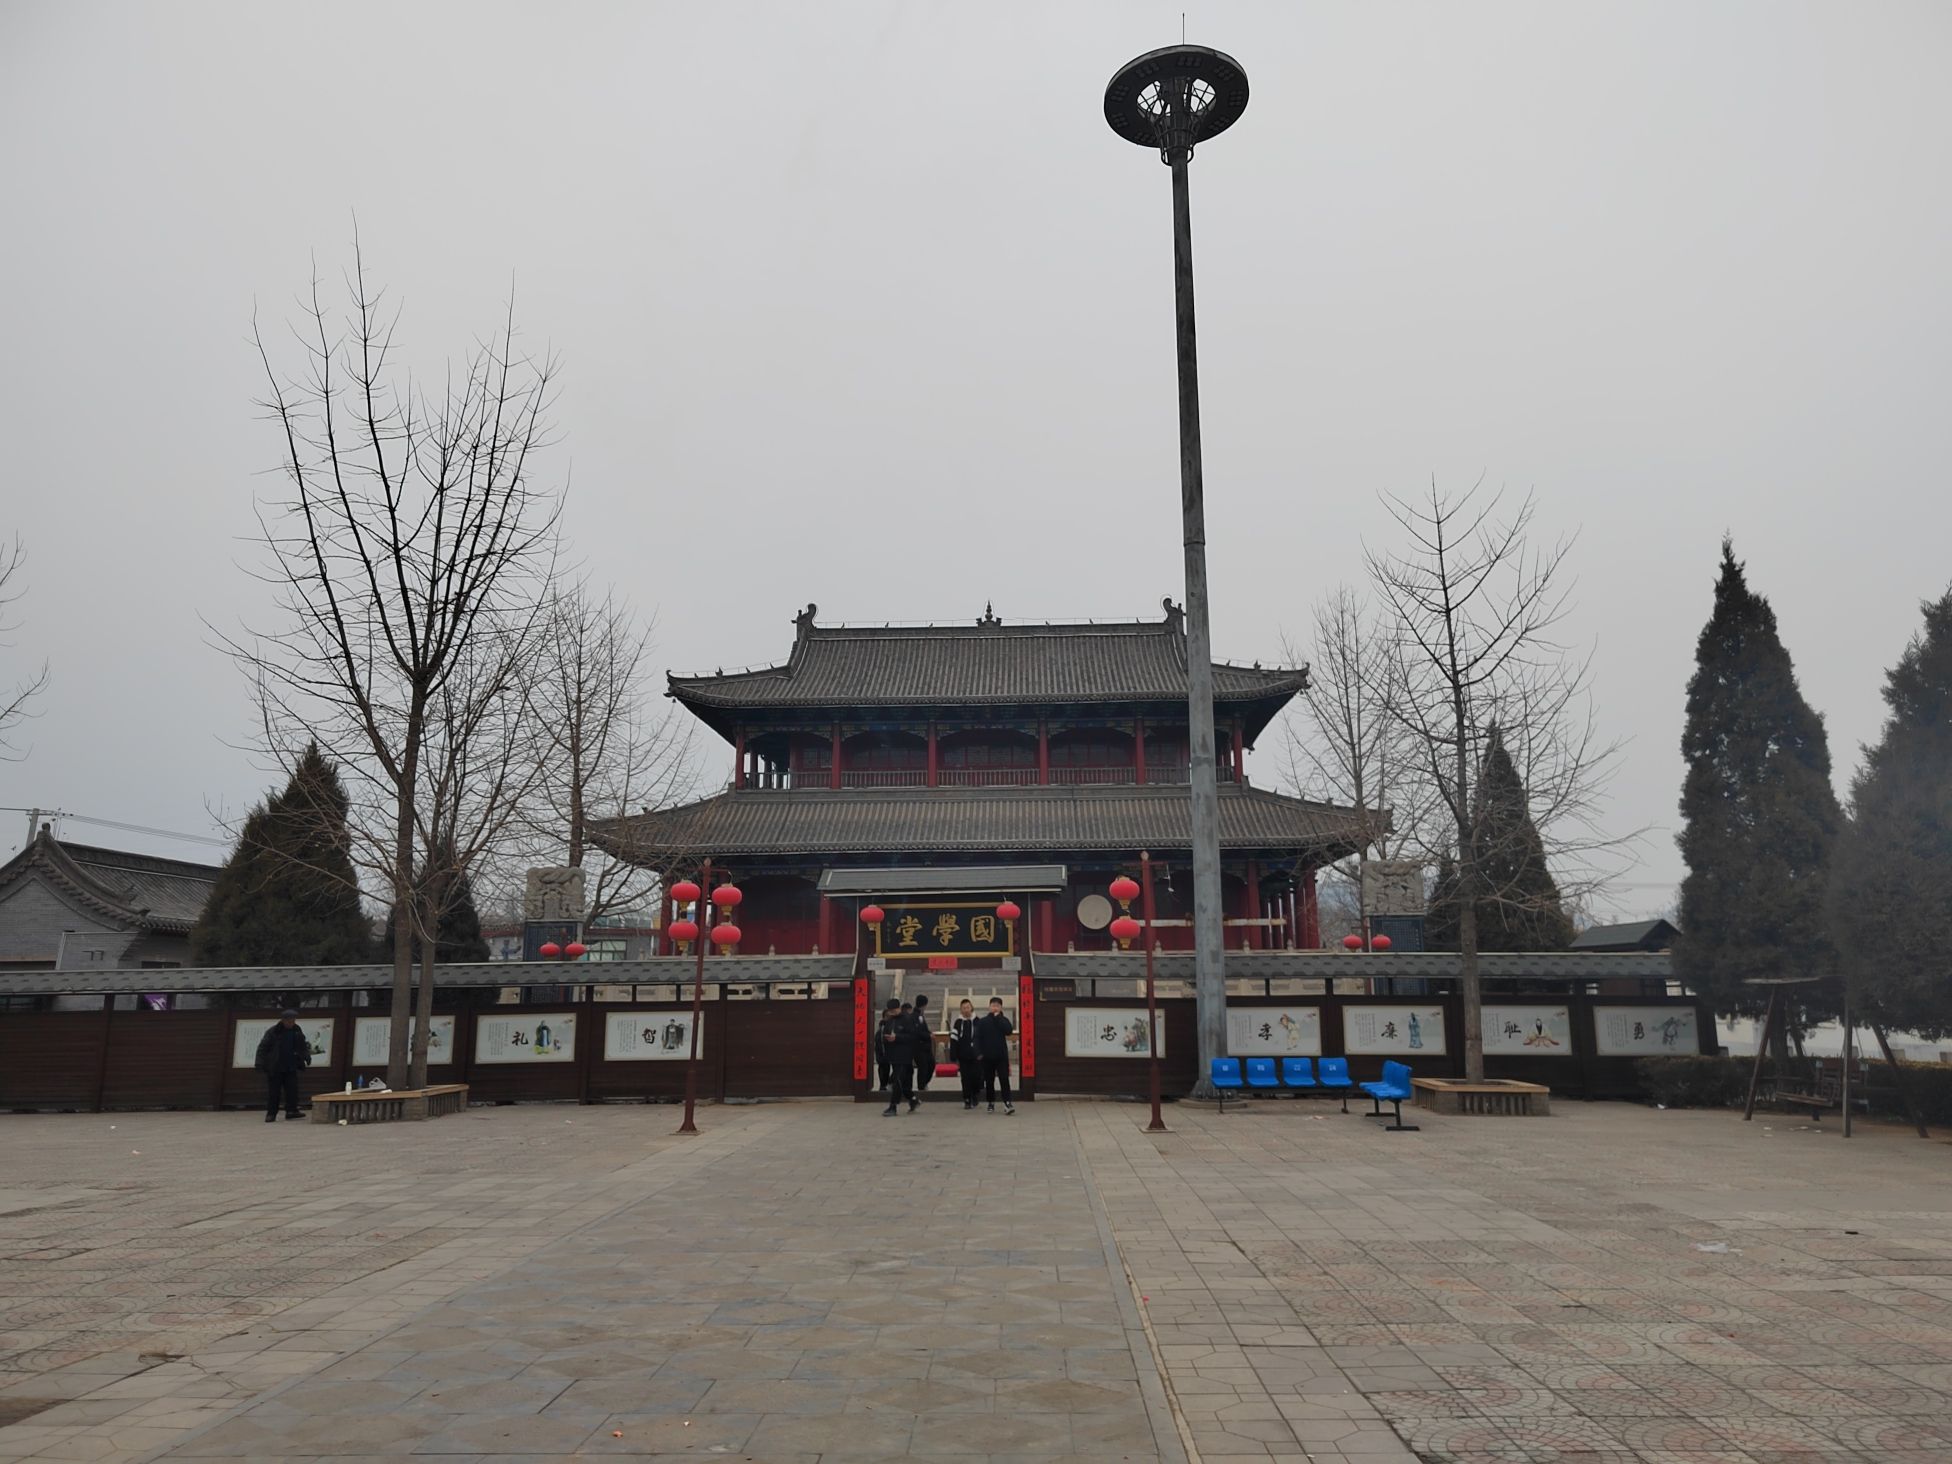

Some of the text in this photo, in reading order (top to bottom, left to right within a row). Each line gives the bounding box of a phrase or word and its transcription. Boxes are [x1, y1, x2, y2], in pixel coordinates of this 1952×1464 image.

[1100, 1023, 1118, 1040] 忠
[1258, 1021, 1273, 1039] 孝
[1503, 1020, 1522, 1038] 耻
[511, 1031, 529, 1046] 礼
